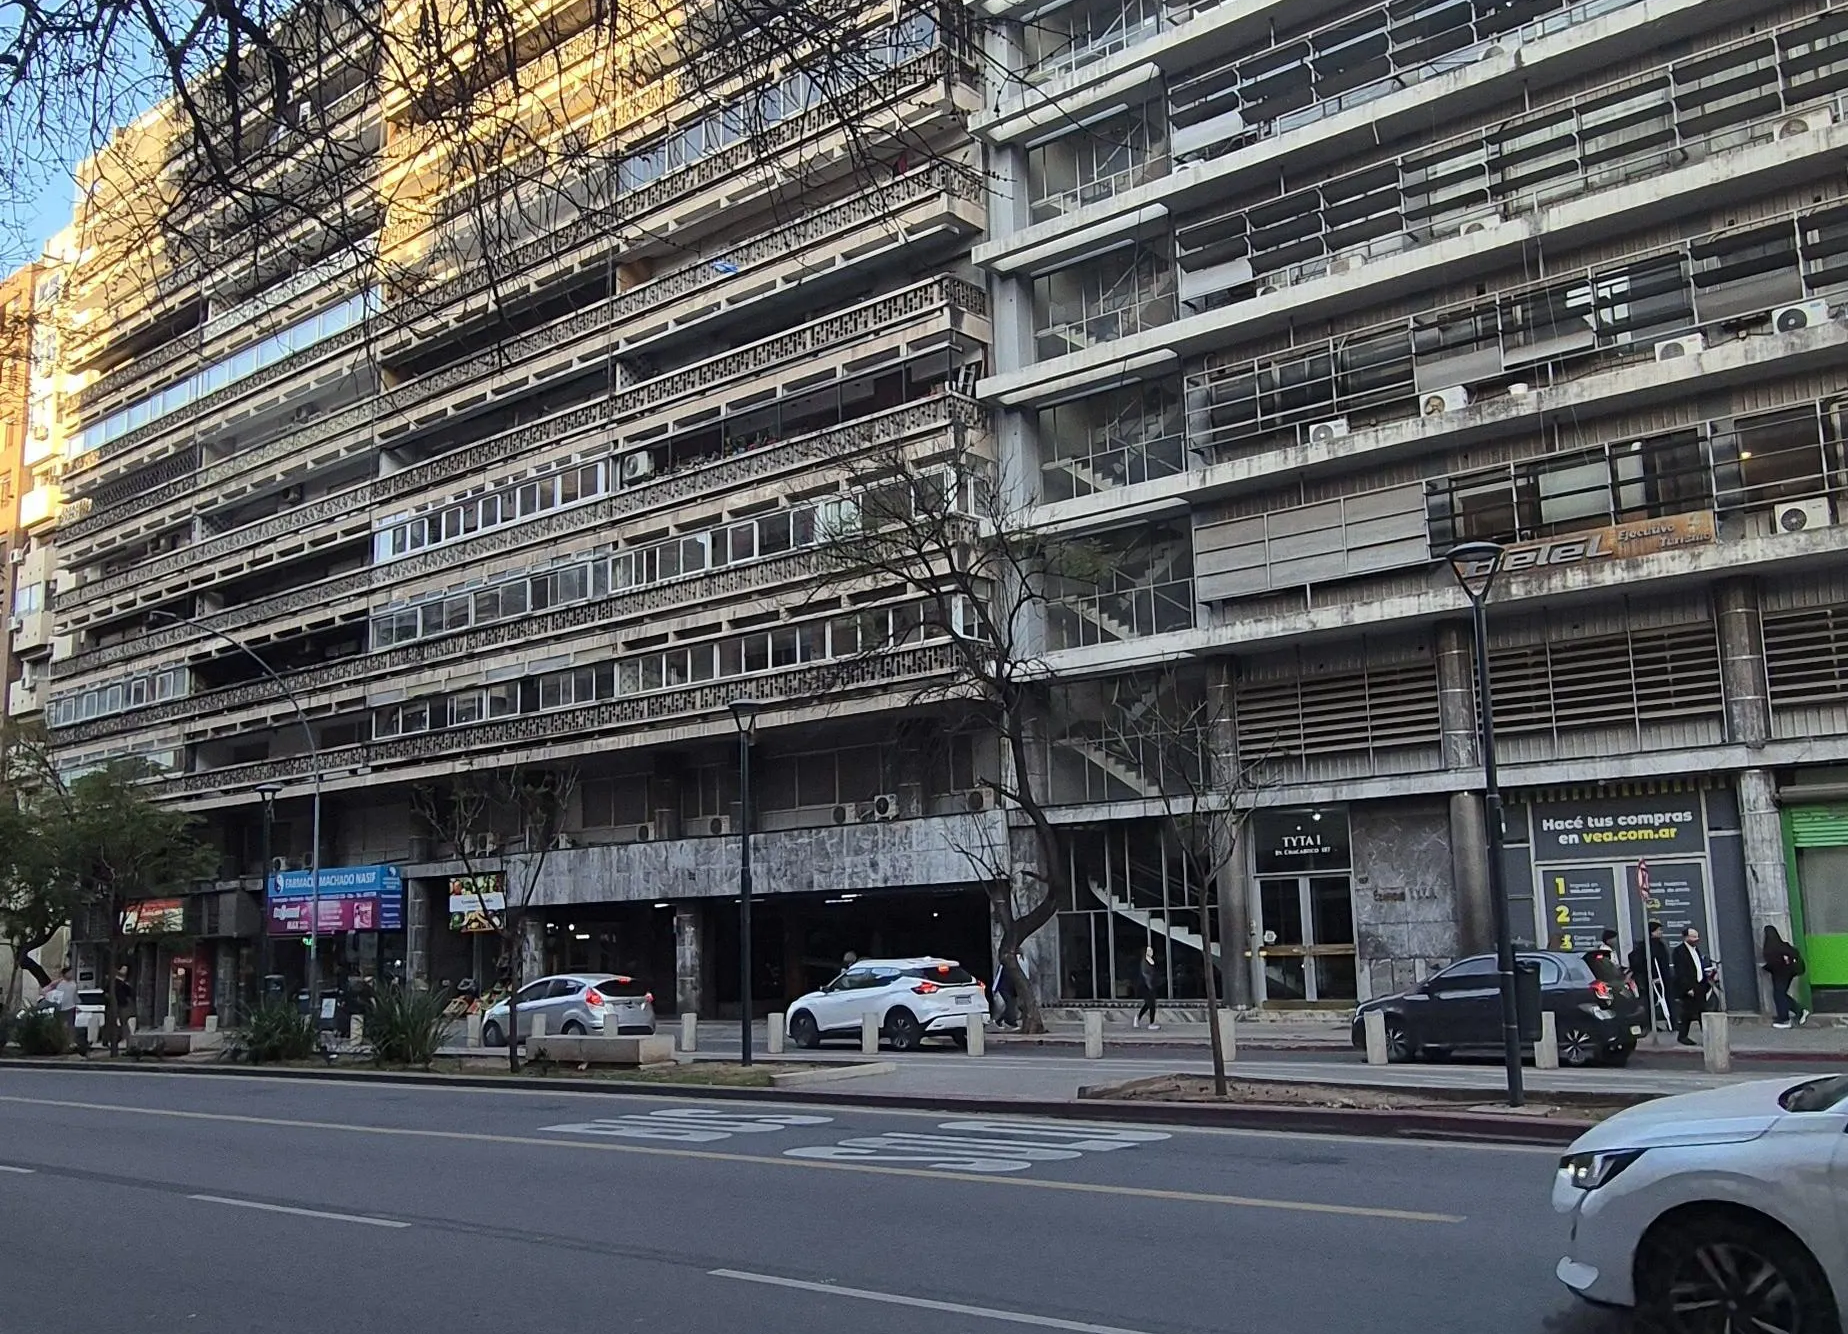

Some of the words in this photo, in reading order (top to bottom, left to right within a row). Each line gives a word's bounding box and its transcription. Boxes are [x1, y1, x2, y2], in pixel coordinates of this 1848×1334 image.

[1542, 816, 1584, 831] Hacé
[1587, 816, 1614, 828] tus
[1617, 811, 1693, 827] compras
[1281, 835, 1314, 847] TYTA
[1558, 833, 1580, 845] en
[1582, 827, 1677, 844] vea.com.ar
[1555, 877, 1566, 895] 1
[1555, 904, 1571, 923] 2
[536, 1108, 834, 1142] BUS
[782, 1120, 1173, 1172] SOLO
